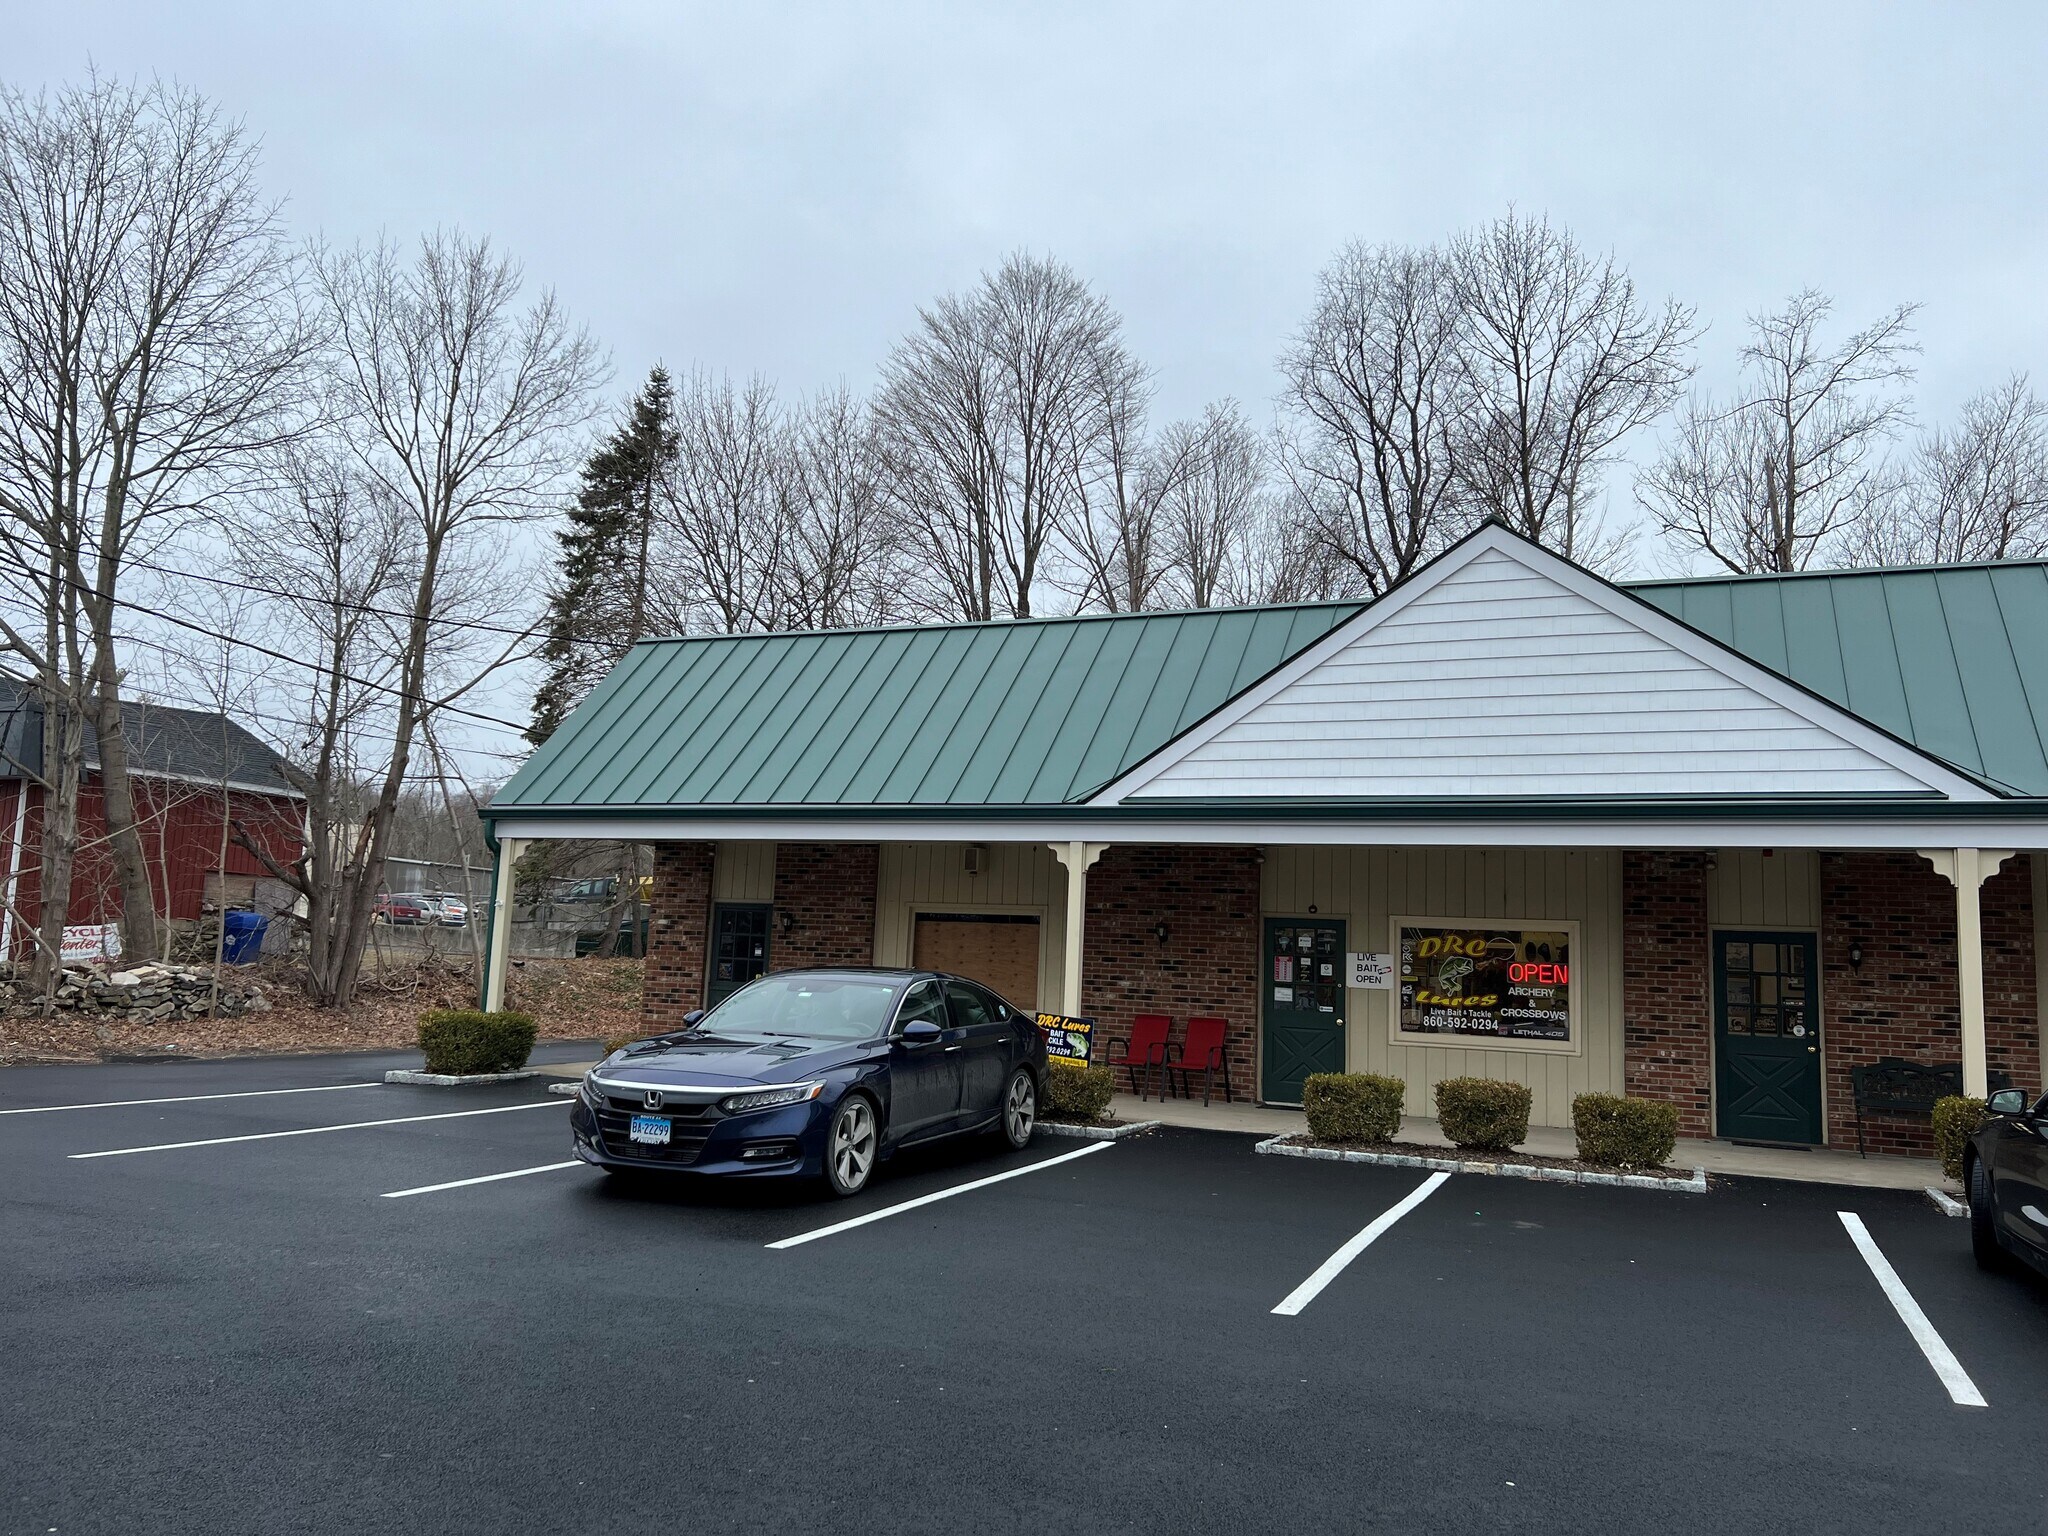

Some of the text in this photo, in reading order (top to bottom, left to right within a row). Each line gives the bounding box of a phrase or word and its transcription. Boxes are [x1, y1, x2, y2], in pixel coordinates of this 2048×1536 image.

[1418, 935, 1487, 957] DRC
[1357, 953, 1377, 962] LIVE
[1356, 964, 1379, 973] BAIT
[1508, 963, 1568, 984] OPEN
[1355, 975, 1382, 984] OPEN
[1508, 987, 1555, 998] ARCHERY
[1416, 991, 1498, 1006] Lures
[1528, 999, 1536, 1008] &
[1430, 1007, 1446, 1016] Live
[1447, 1008, 1462, 1017] Bait
[1468, 1009, 1492, 1018] Tackle
[1500, 1008, 1566, 1020] CROSSBOWS
[1038, 1014, 1091, 1033] DRC Lures
[1423, 1015, 1499, 1030] 860-592-0294
[1050, 1029, 1065, 1038] BAIT
[1513, 1029, 1544, 1037] LETHAL
